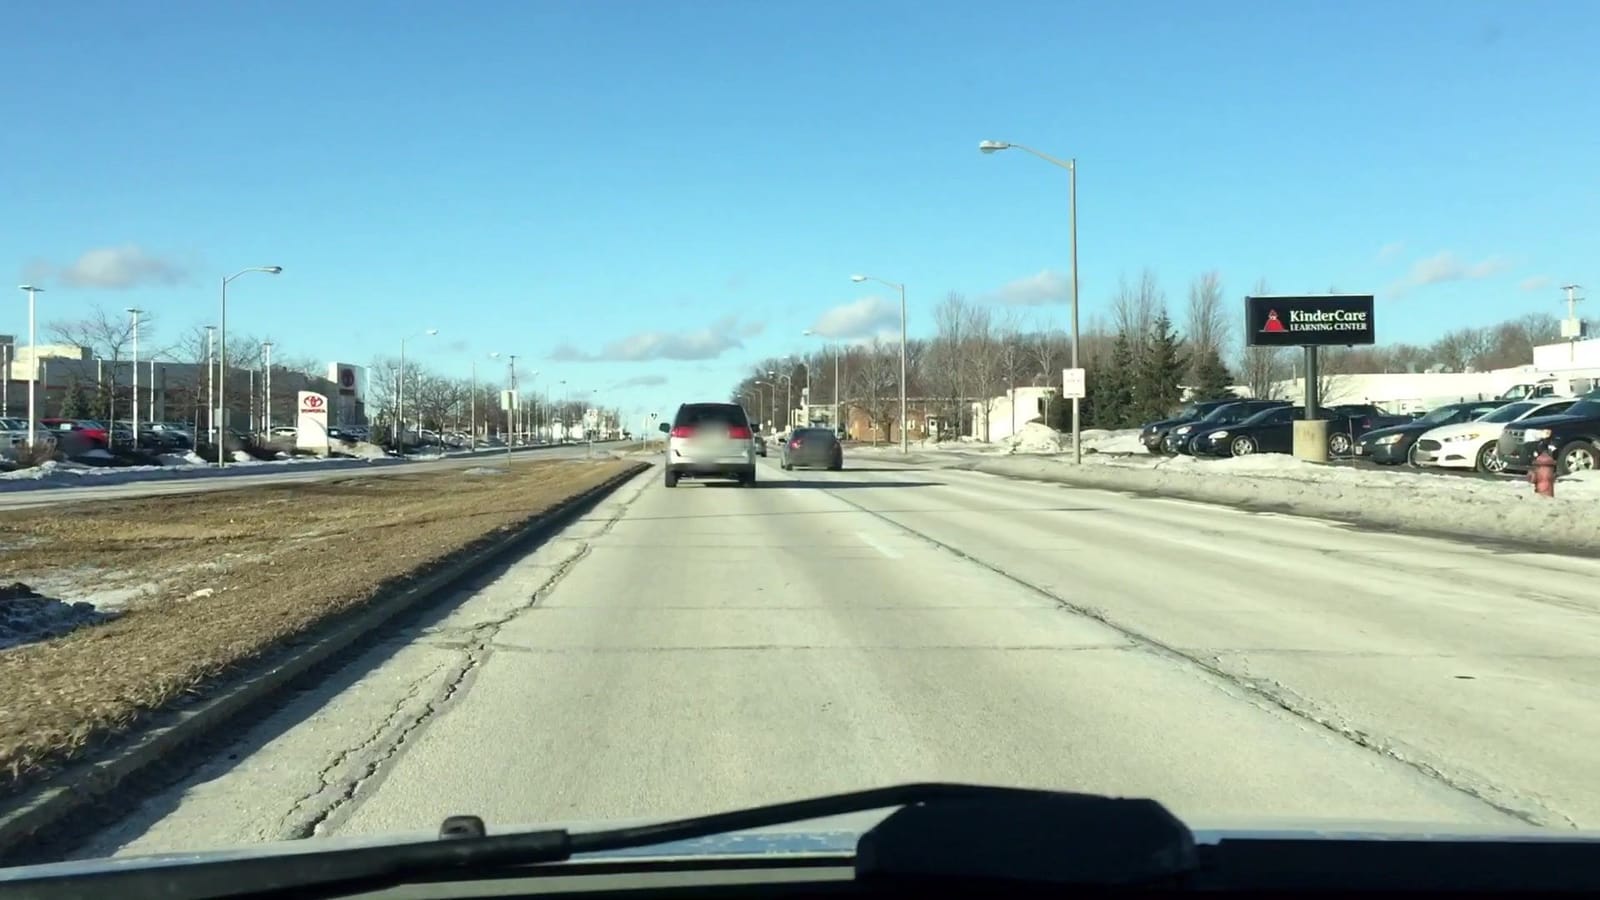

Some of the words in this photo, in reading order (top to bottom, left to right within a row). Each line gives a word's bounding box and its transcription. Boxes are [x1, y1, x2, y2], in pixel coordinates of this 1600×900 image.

[1290, 310, 1367, 322] KinderCare
[1290, 323, 1333, 331] LEARNING
[1334, 322, 1367, 331] CENTER
